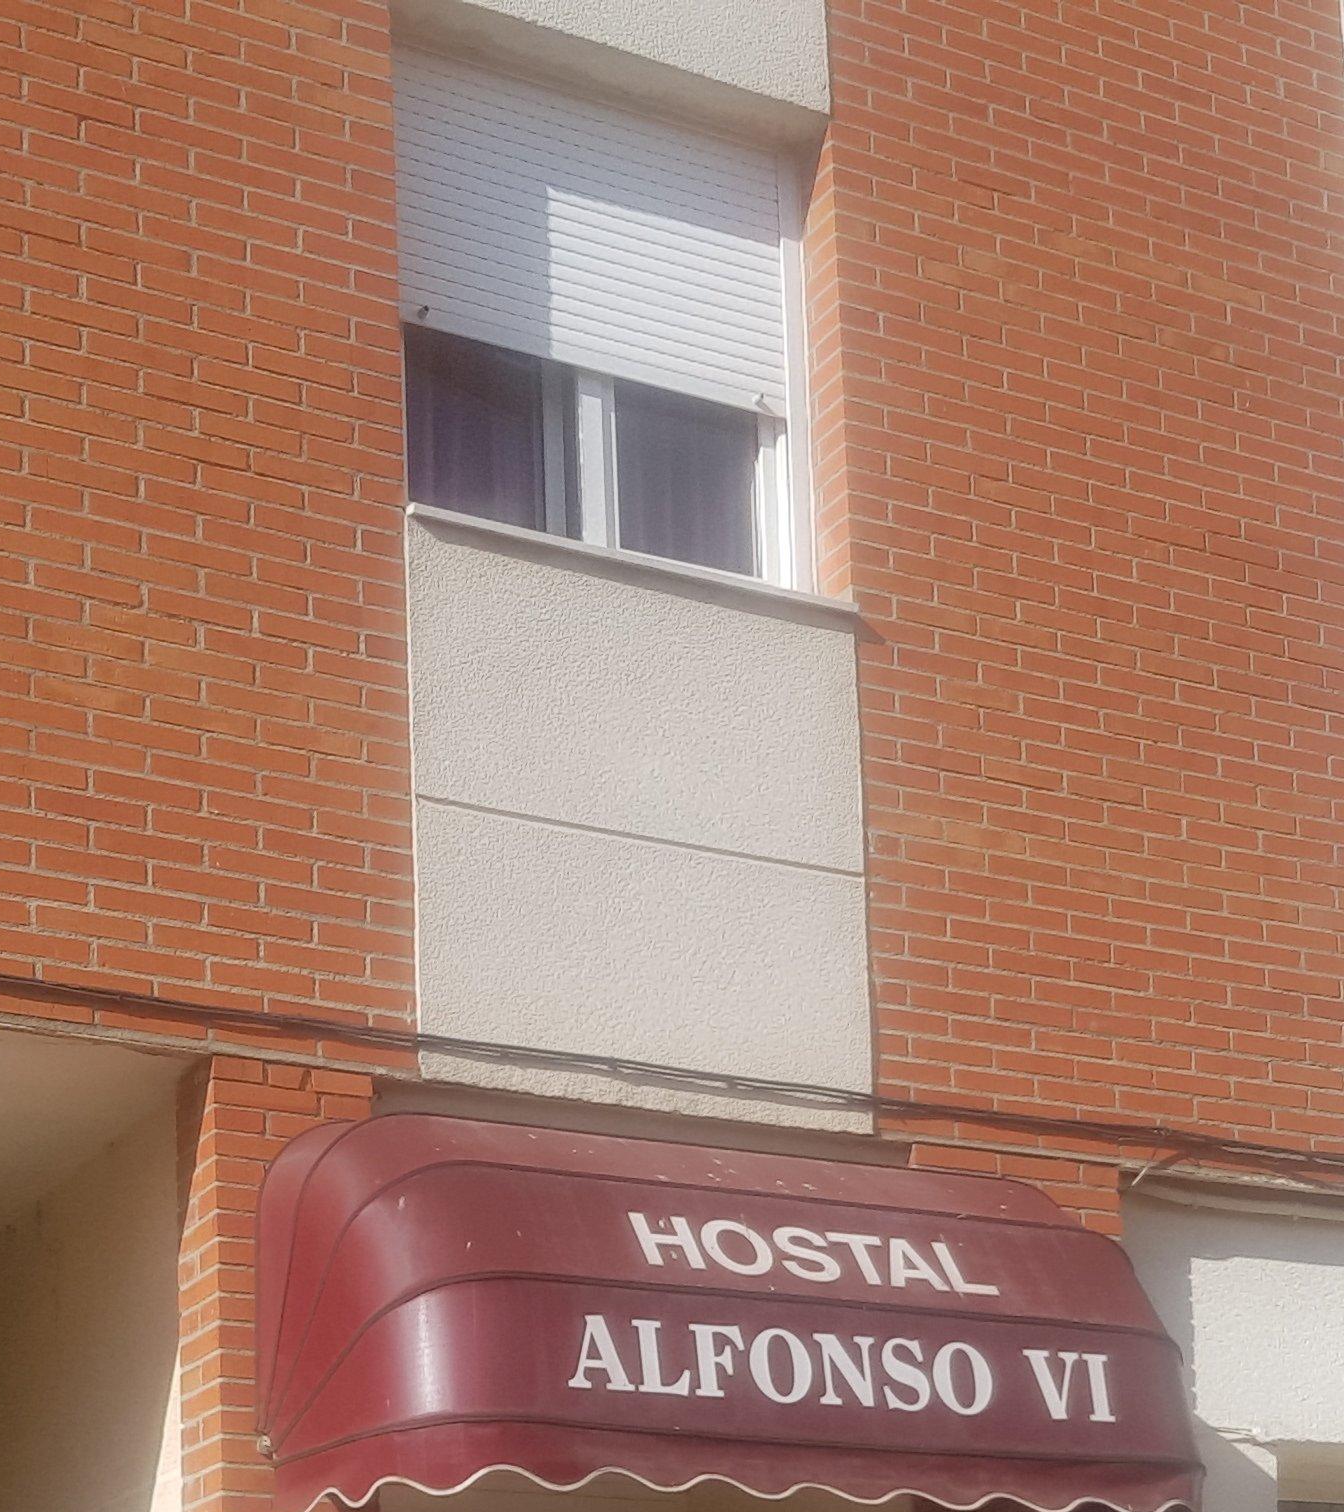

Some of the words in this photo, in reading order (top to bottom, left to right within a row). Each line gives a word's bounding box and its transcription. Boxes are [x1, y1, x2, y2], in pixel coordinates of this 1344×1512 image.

[628, 1211, 999, 1297] HOSTAL
[567, 1314, 994, 1416] ALFONSO
[1021, 1347, 1118, 1423] VI
